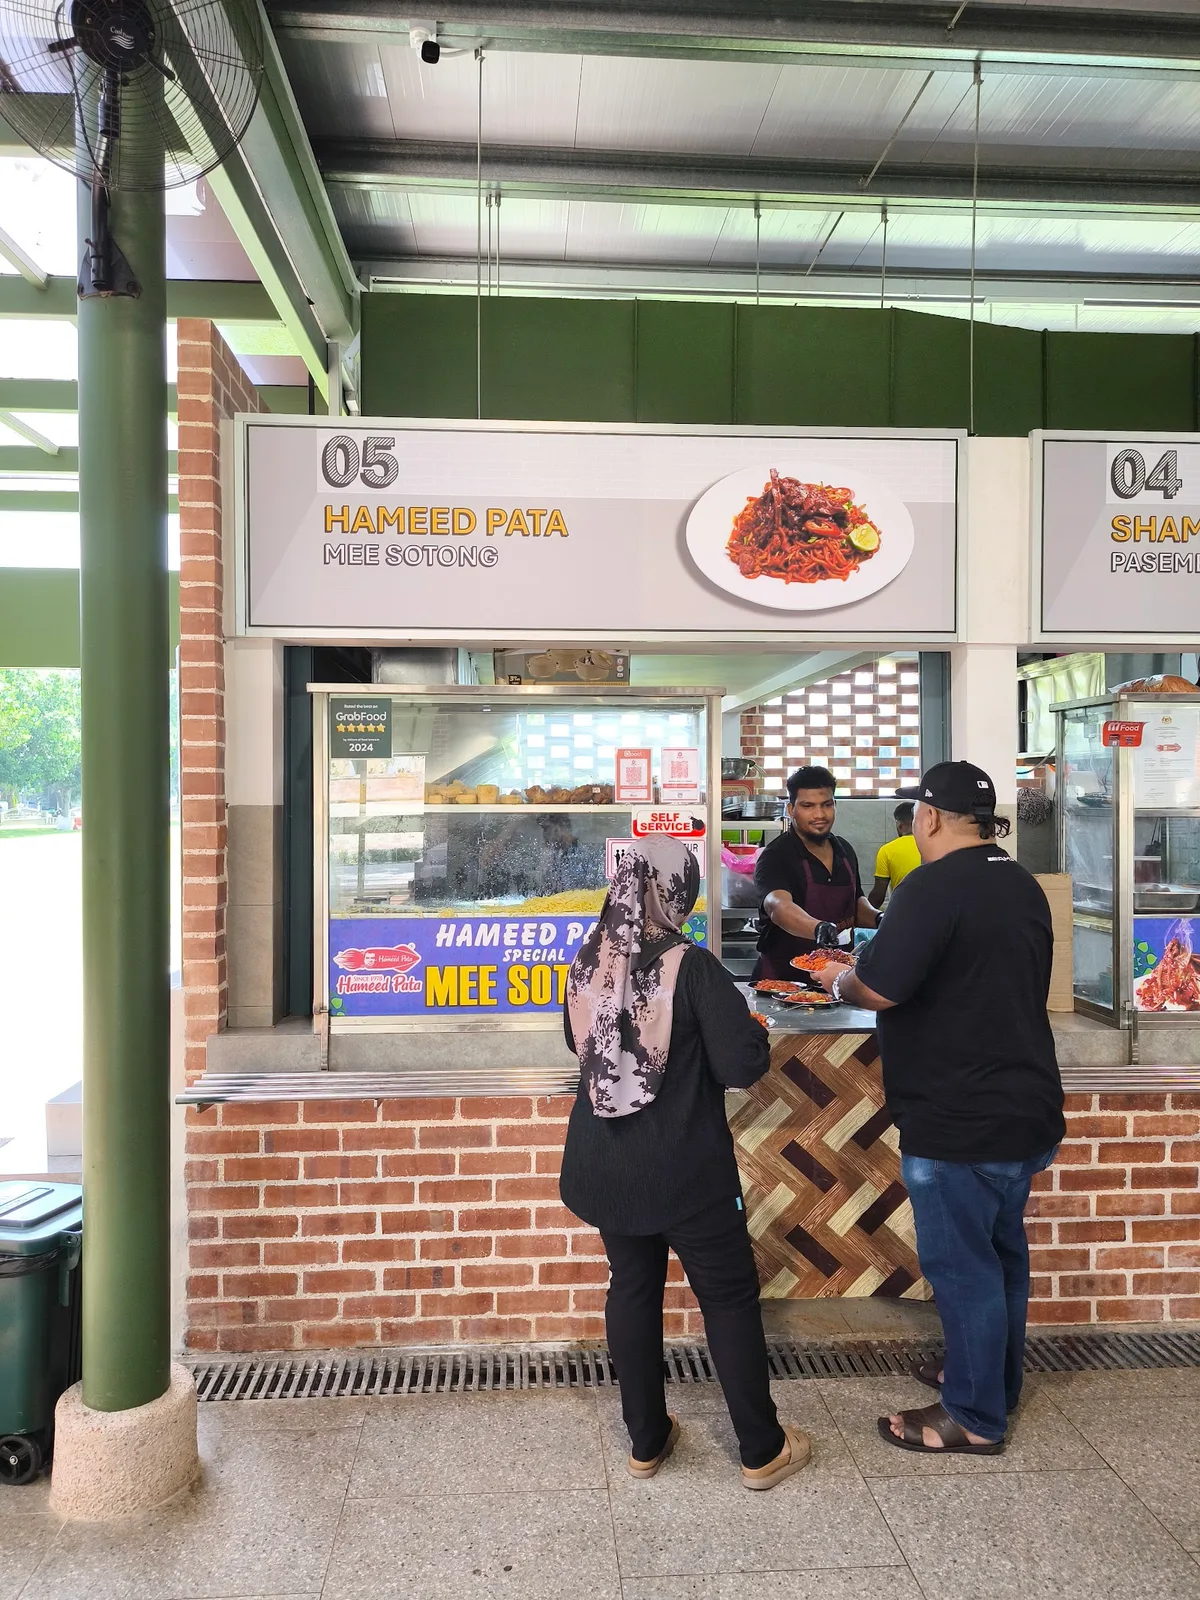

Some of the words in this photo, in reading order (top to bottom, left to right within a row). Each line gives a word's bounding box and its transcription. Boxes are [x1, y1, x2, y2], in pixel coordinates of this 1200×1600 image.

[321, 435, 399, 488] 05
[1110, 449, 1182, 499] 04
[324, 504, 477, 536] HAMEED
[486, 507, 569, 538] PATA
[1111, 515, 1200, 543] SHAM
[323, 543, 380, 566] MEE
[385, 544, 499, 568] SOTONG
[335, 711, 387, 721] GrabFood
[349, 743, 374, 752] 2024
[640, 822, 691, 831] SERVICE
[651, 812, 680, 822] SELF
[436, 923, 557, 948] HAMEED
[378, 955, 400, 963] Hameed
[401, 955, 413, 963] Pata
[502, 948, 566, 962] SPECIAL
[338, 976, 389, 993] Hameed
[393, 975, 421, 992] Pata
[426, 965, 498, 1007] MEE
[507, 964, 571, 1006] SOT
